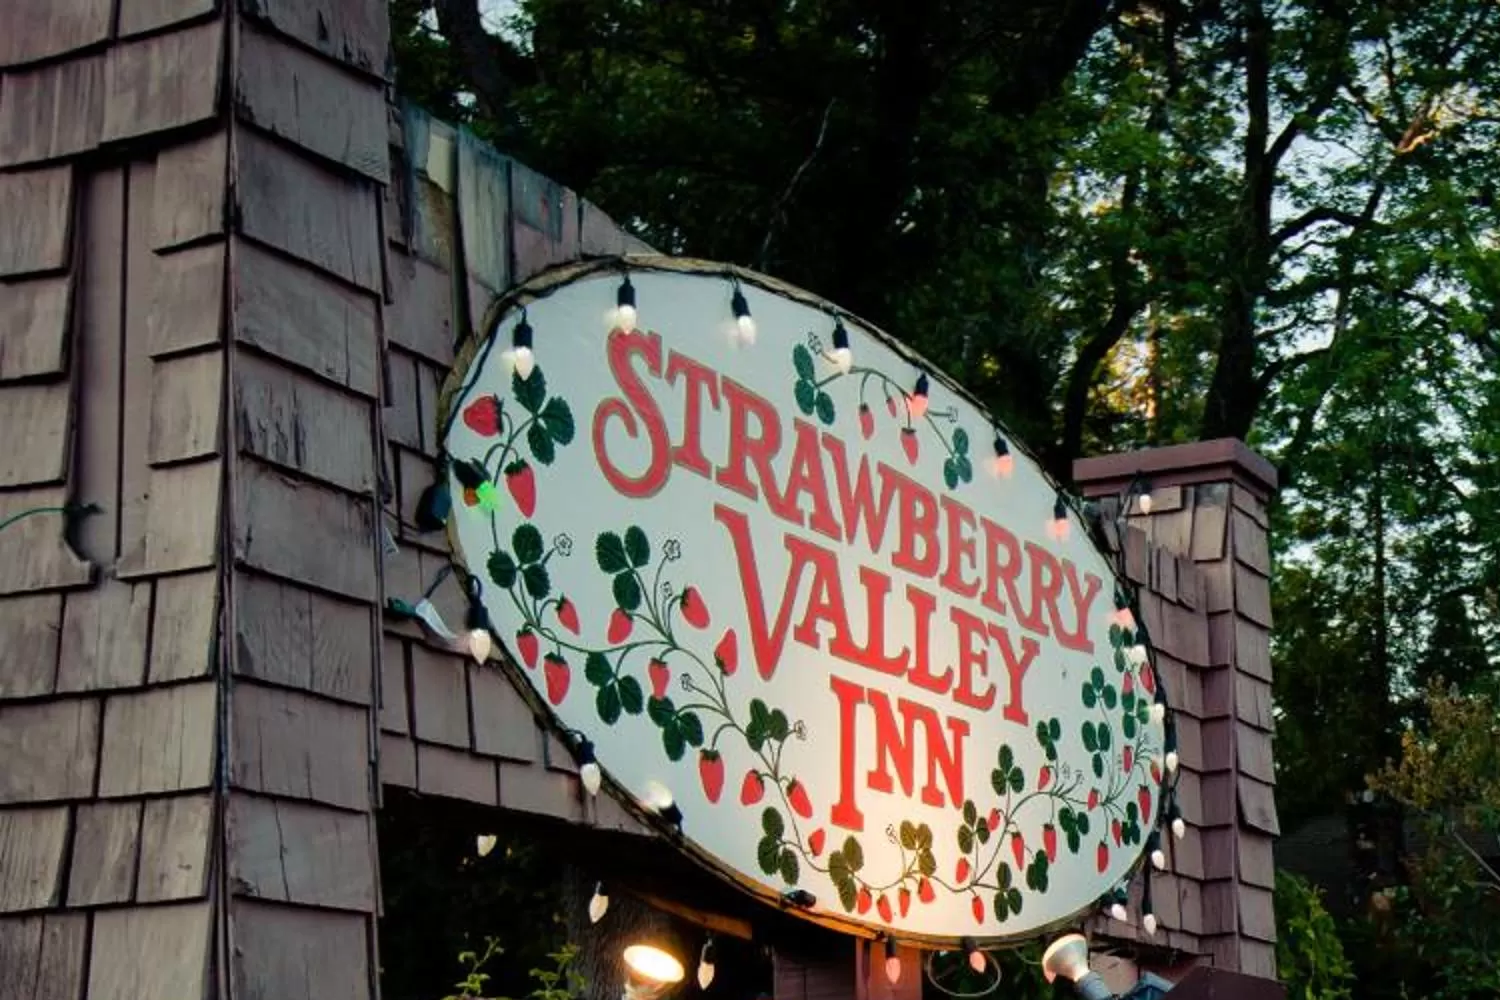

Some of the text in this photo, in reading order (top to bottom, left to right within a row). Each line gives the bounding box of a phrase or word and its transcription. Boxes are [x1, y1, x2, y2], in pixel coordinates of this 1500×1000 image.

[592, 326, 1102, 654] STRAWBERRY
[713, 503, 1041, 727] VALLEY
[829, 674, 971, 832] INN
